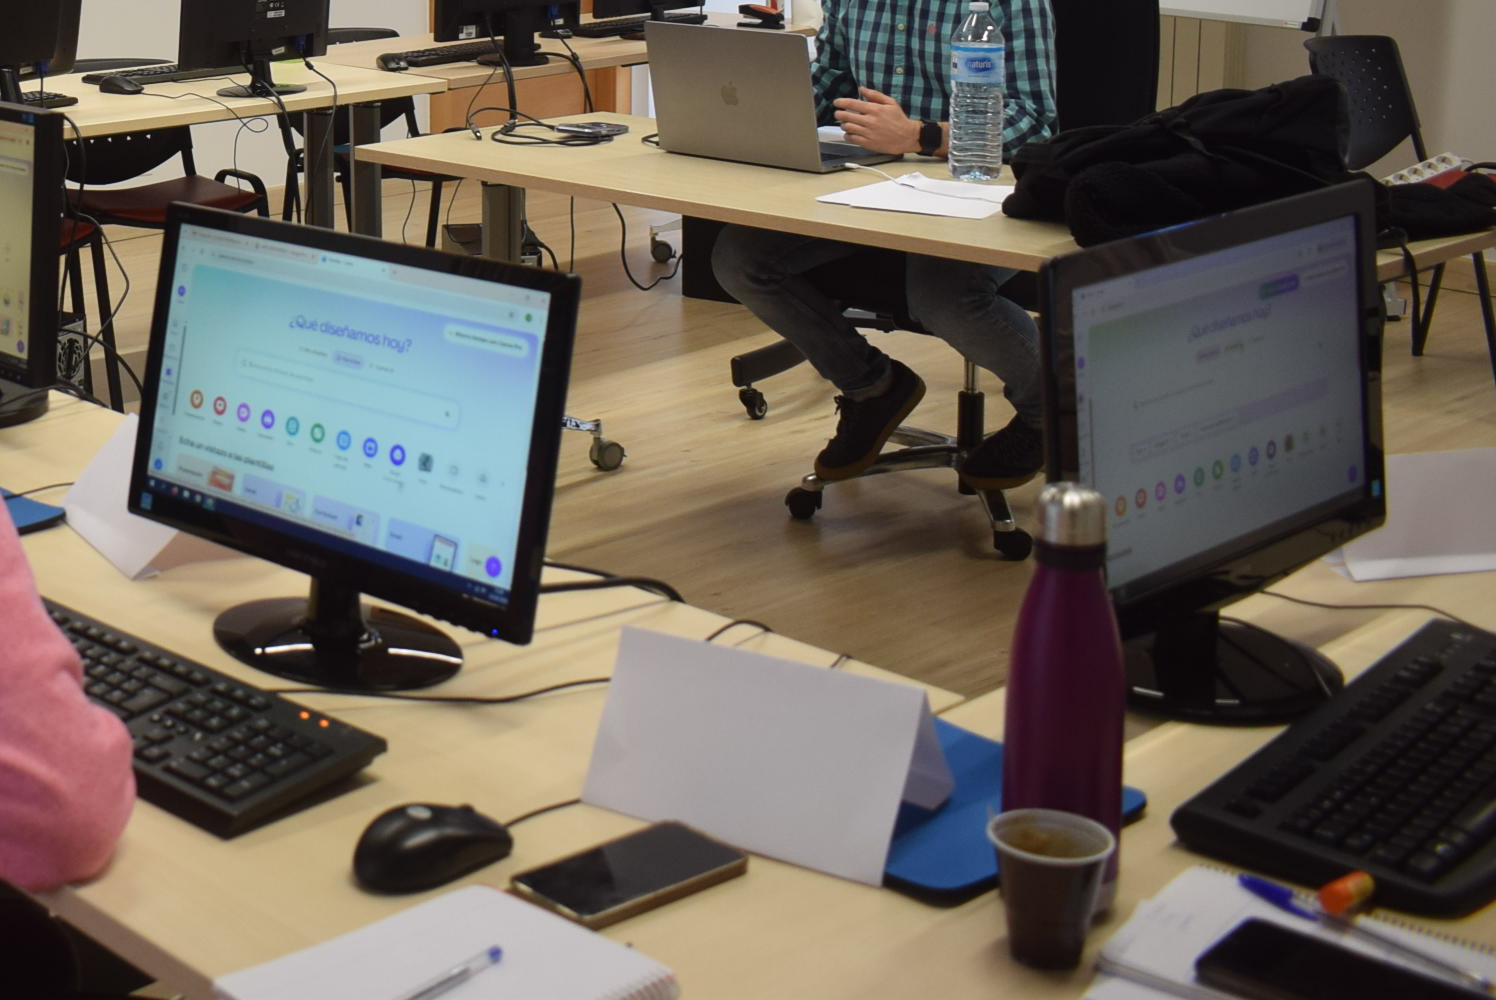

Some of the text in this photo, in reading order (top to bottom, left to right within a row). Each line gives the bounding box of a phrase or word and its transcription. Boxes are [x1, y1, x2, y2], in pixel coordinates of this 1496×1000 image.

[288, 313, 413, 354] ¿Qué diseñamos hoy?
